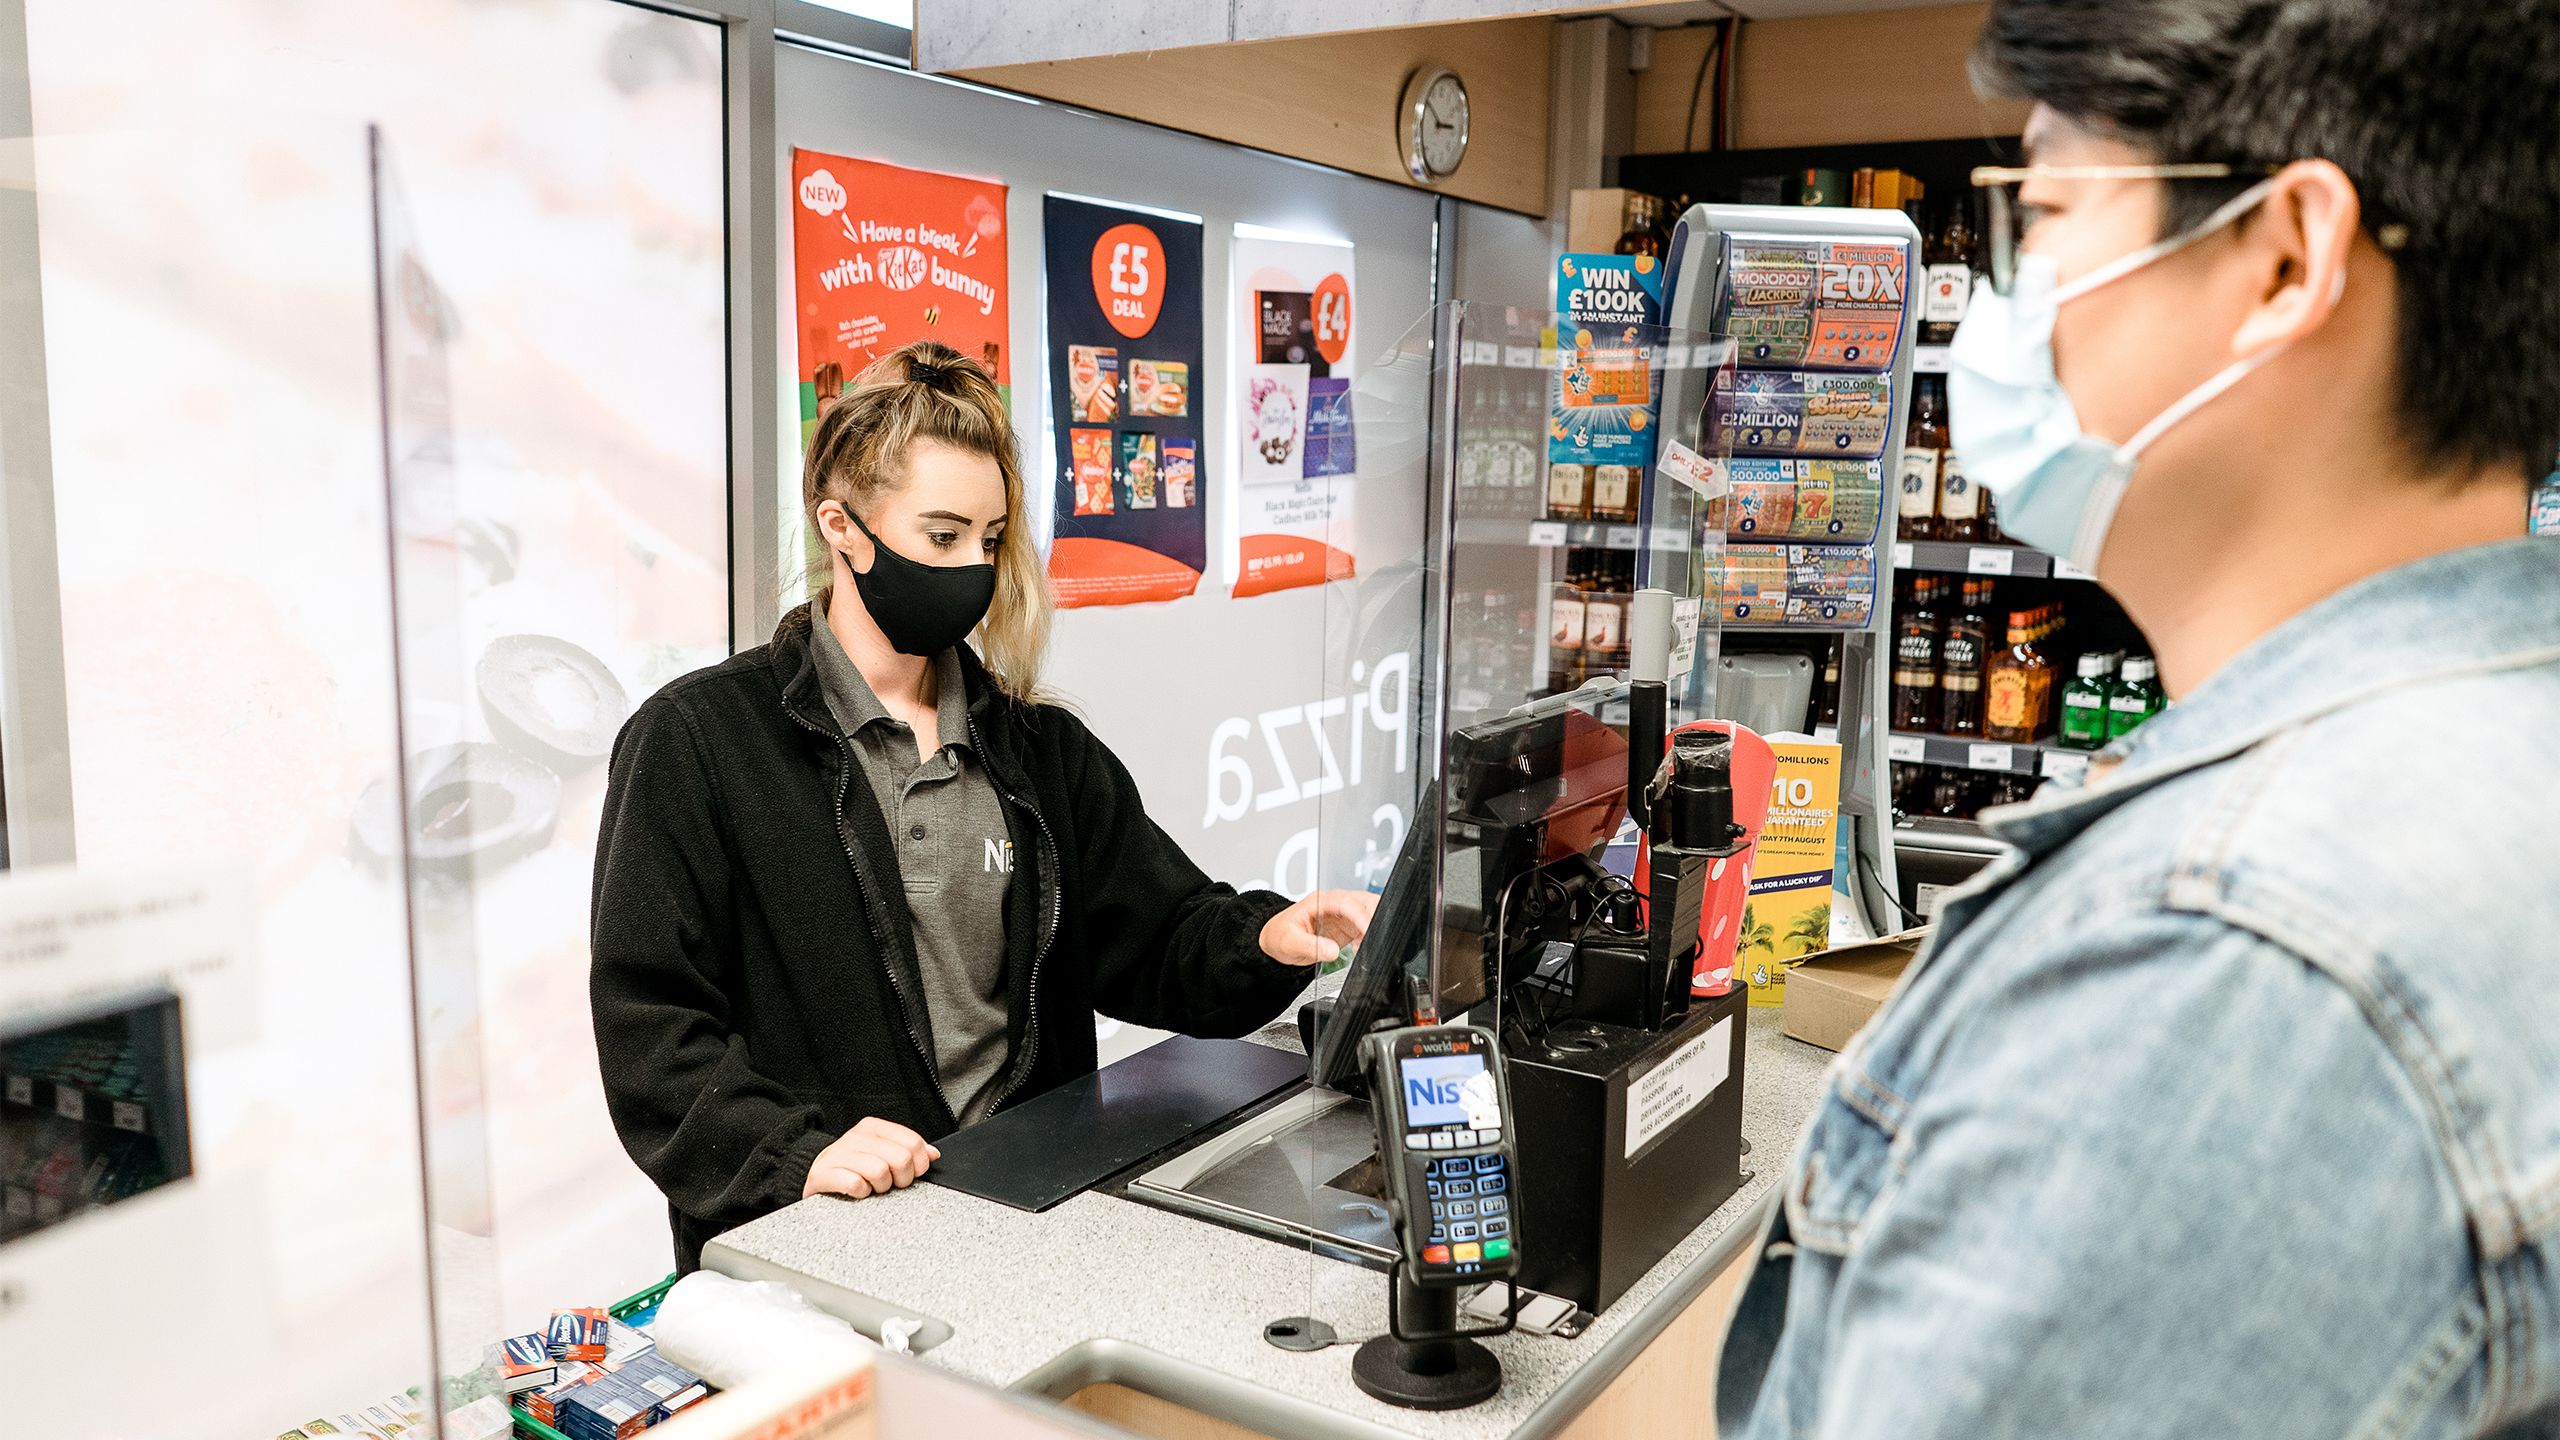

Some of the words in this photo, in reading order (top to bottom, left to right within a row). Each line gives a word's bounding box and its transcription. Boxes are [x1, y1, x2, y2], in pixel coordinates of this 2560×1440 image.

[805, 186, 841, 202] NEW
[860, 220, 901, 243] Have
[905, 228, 916, 243] a
[919, 223, 961, 256] break
[1850, 252, 1893, 262] MILLION
[1109, 242, 1149, 296] £5
[819, 253, 873, 292] with
[931, 256, 995, 315] bunny
[1581, 267, 1630, 290] WIN
[1737, 273, 1810, 286] MONOPOLY
[1822, 263, 1903, 302] 20X
[1568, 289, 1645, 313] £100K
[1752, 289, 1799, 301] JACKPOT
[1113, 299, 1146, 319] DEAL
[1318, 291, 1347, 342] £4
[1759, 347, 1766, 356] 1
[1848, 350, 1856, 359] 2
[1823, 380, 1875, 390] £300,000
[1808, 396, 1872, 420] Bingo
[1751, 434, 1759, 444] 3
[1839, 436, 1847, 446] 4
[1744, 521, 1752, 530] 5
[1831, 523, 1839, 532] 6
[1739, 607, 1747, 616] 7
[1826, 608, 1833, 617] 8
[1776, 756, 1829, 765] OMILLIONS
[1749, 883, 1764, 891] ASK
[1764, 881, 1778, 889] FOR
[1784, 877, 1808, 886] LUCKY
[1423, 1041, 1470, 1054] worldpay
[1641, 1082, 1668, 1106] PASSPORT
